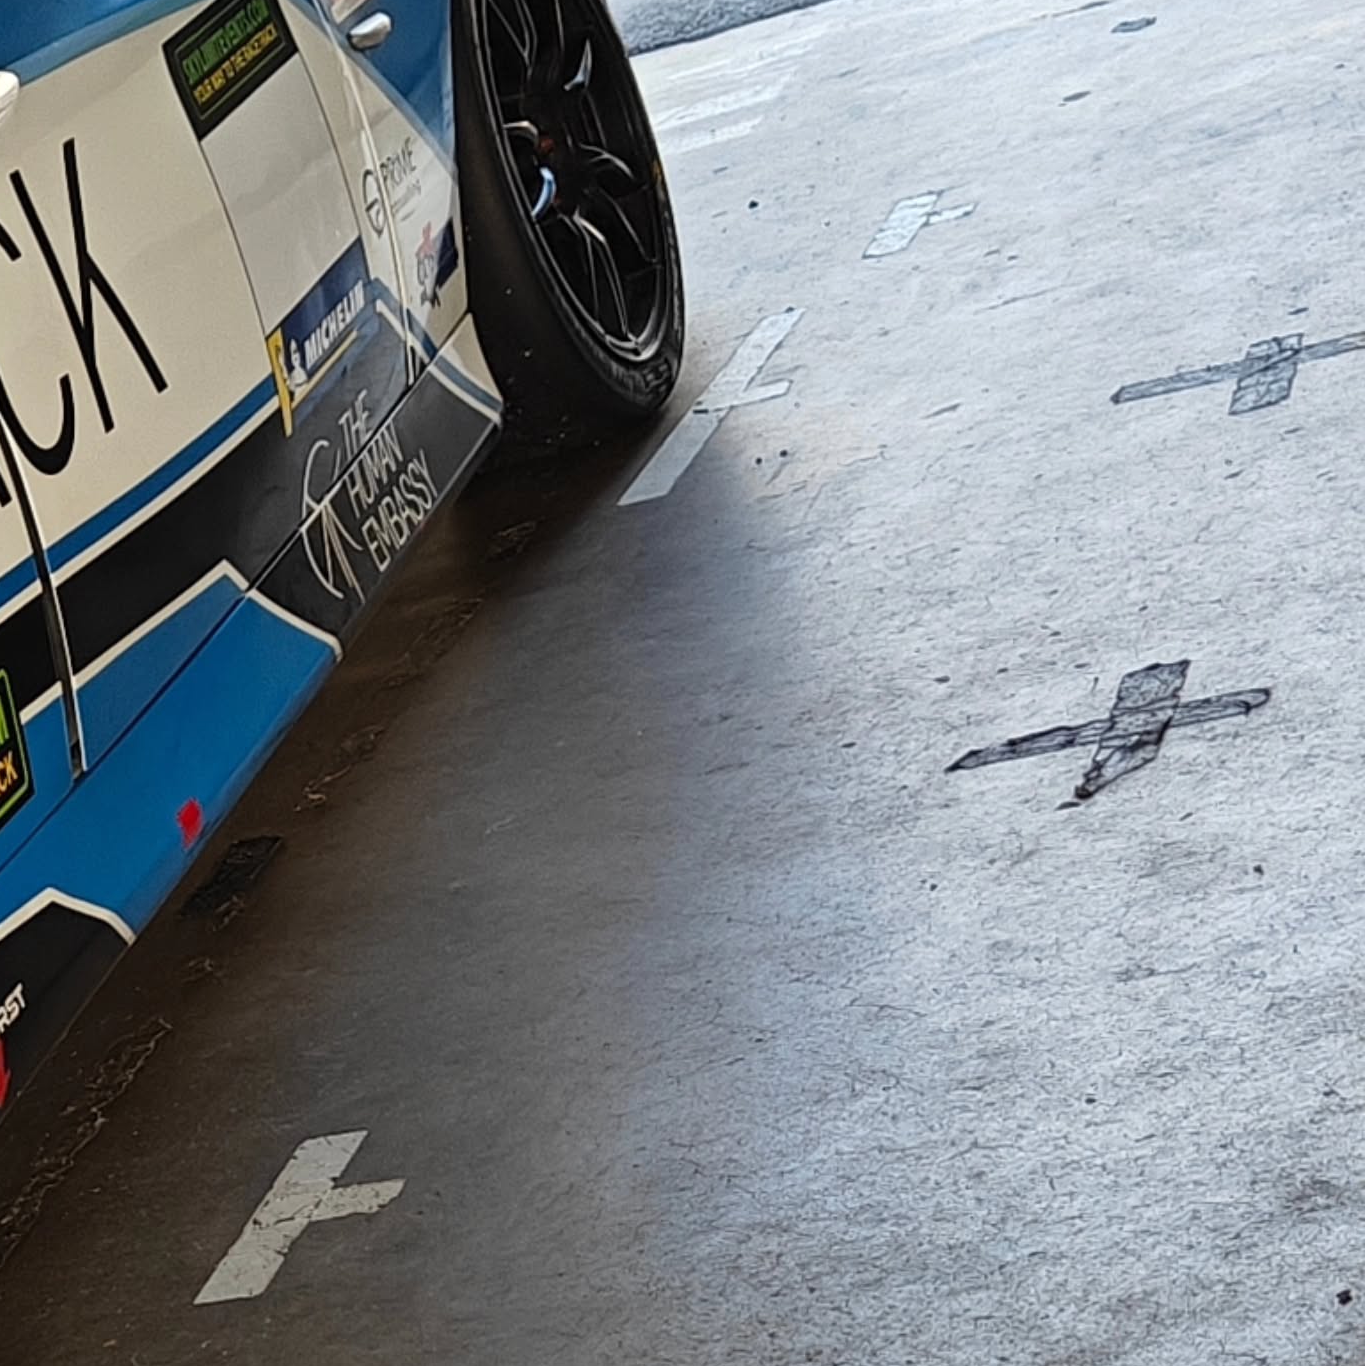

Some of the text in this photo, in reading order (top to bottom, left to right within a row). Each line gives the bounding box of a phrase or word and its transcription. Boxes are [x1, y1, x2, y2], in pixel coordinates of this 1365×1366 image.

[304, 279, 365, 370] MICHELIN
[338, 389, 372, 460] THE
[345, 419, 404, 519] HUMAN
[361, 448, 438, 572] EMBASSY
